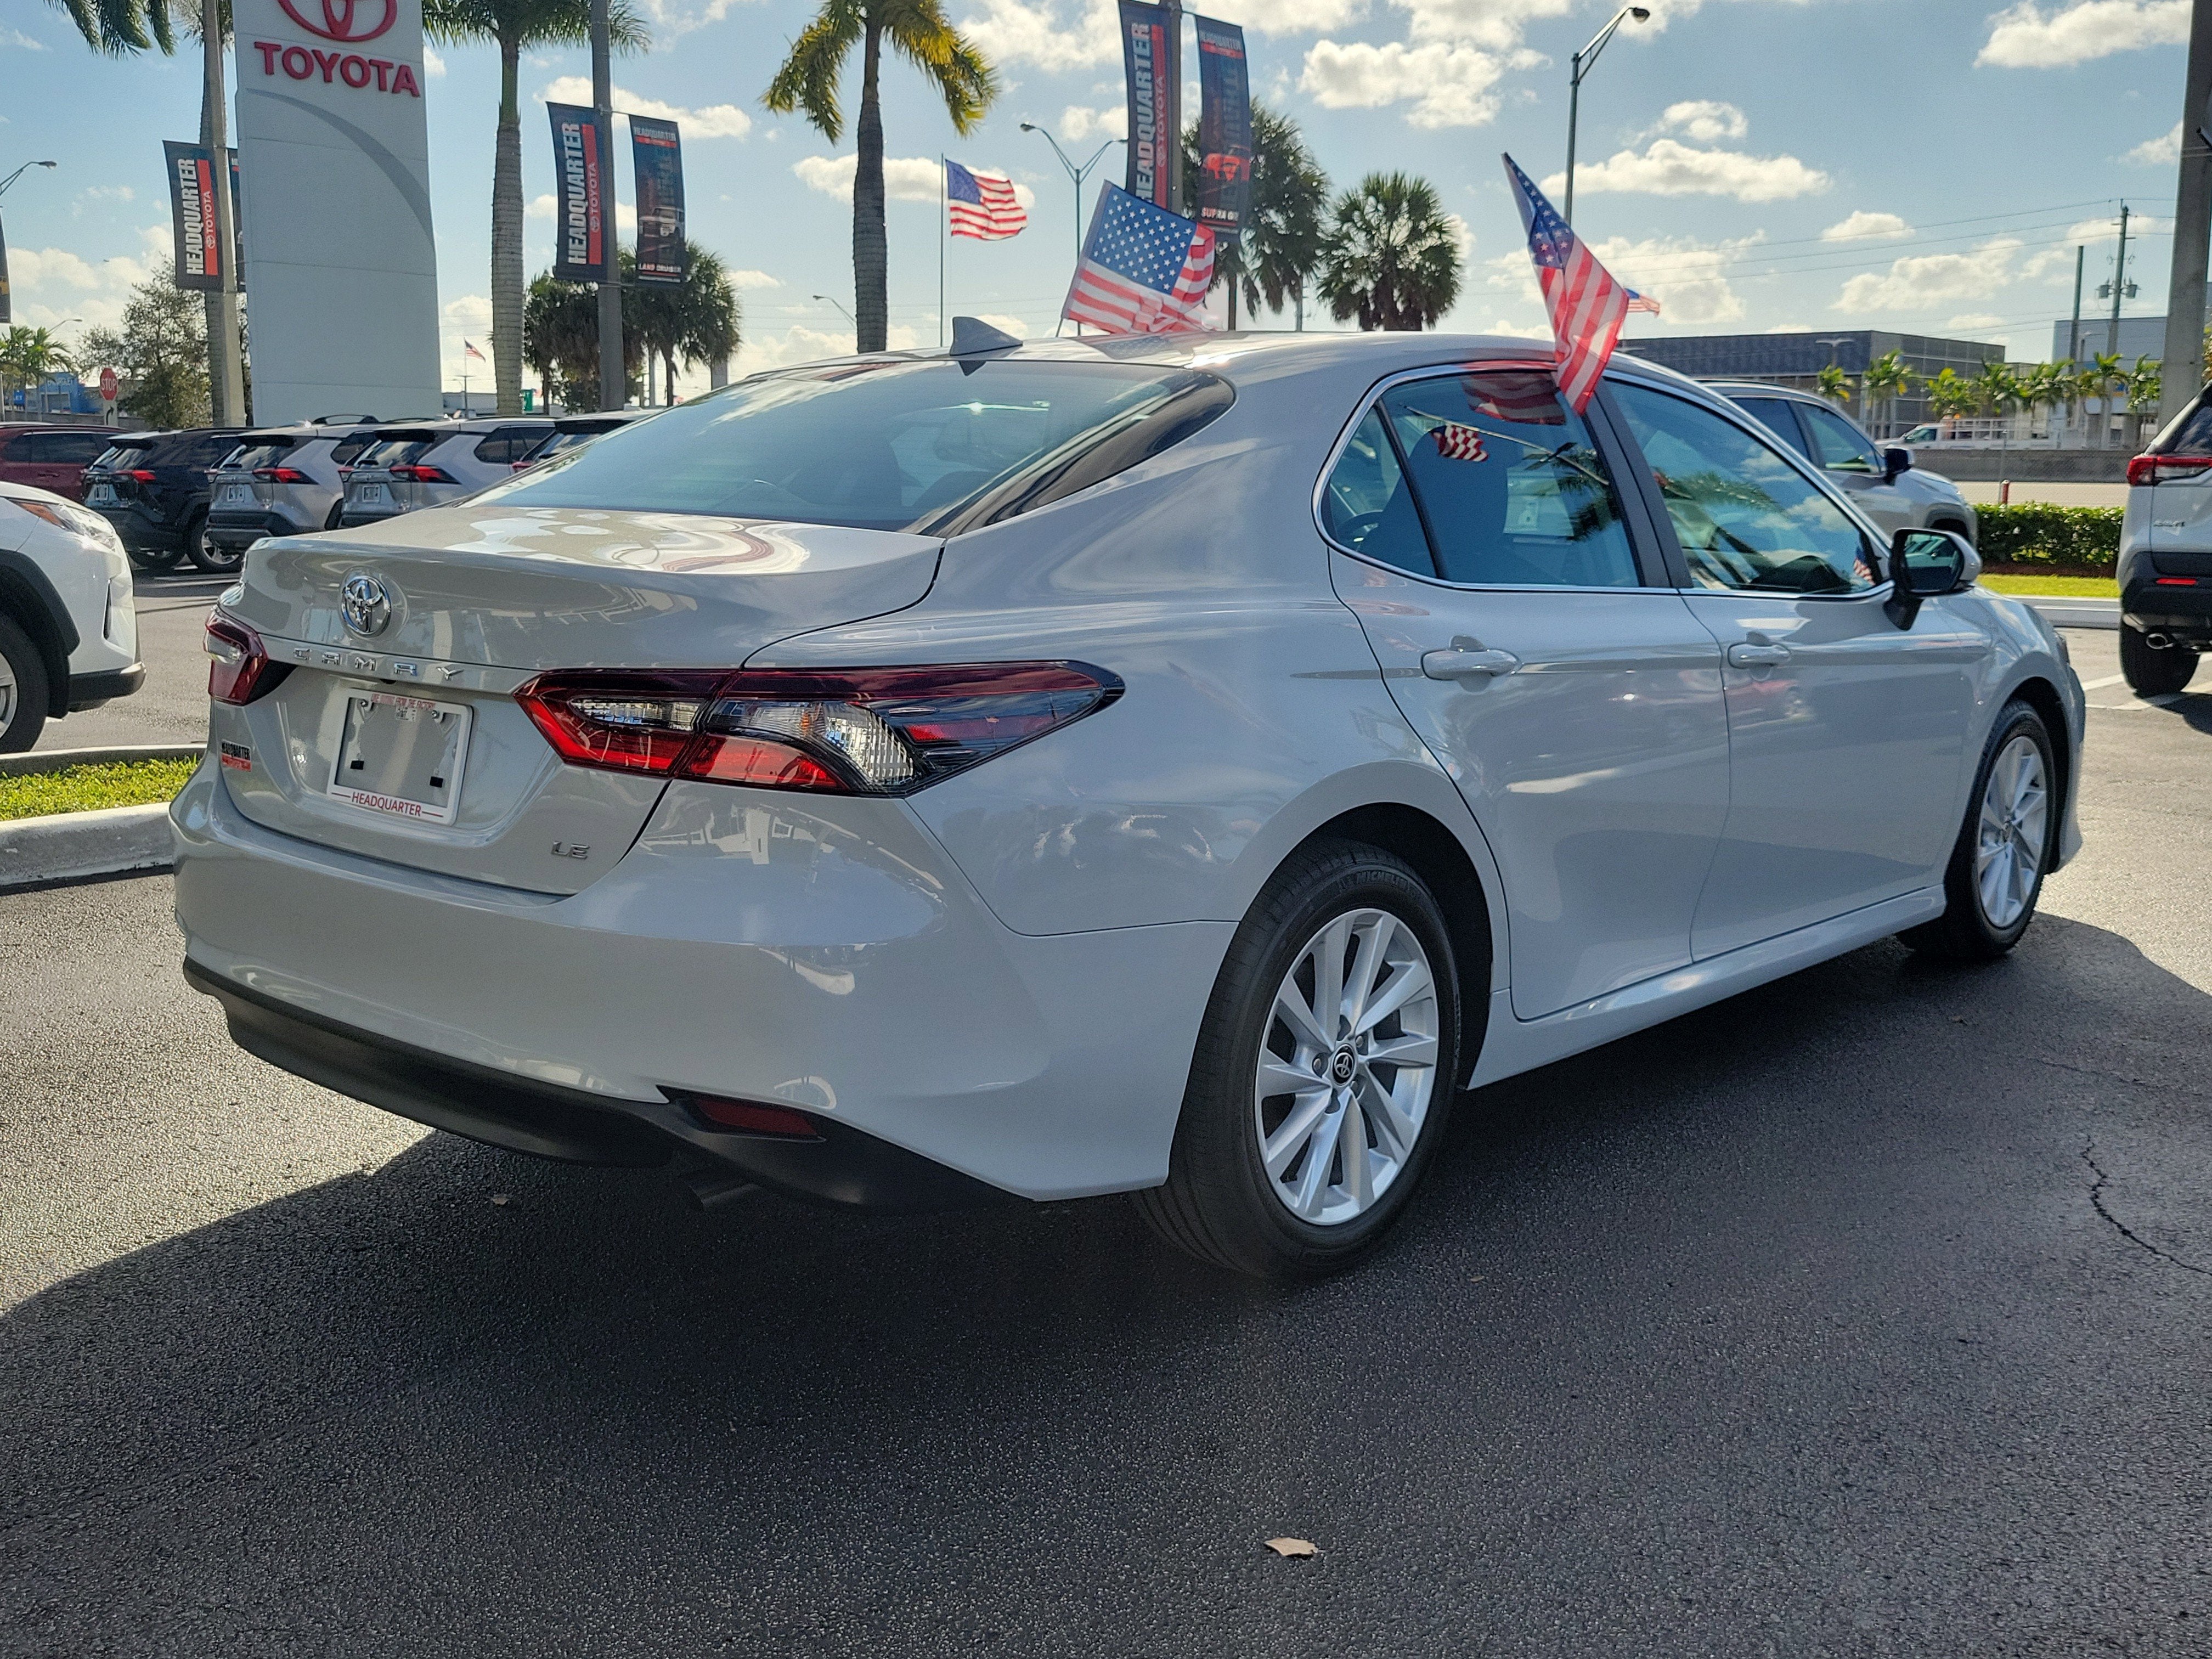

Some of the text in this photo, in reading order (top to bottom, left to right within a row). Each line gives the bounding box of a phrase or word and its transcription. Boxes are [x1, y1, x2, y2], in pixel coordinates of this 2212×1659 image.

[253, 42, 420, 97] TOYOTA
[1155, 76, 1165, 148] TOYOTA
[204, 190, 214, 234] TOYOTA
[562, 123, 588, 265] HEADQUARTER
[589, 163, 599, 214] TOYOTA
[178, 159, 204, 275] HEADQUARTER
[101, 377, 116, 391] STOP
[294, 648, 464, 681] CAMRY
[352, 792, 421, 816] HEADQUARTER
[551, 840, 590, 860] LE
